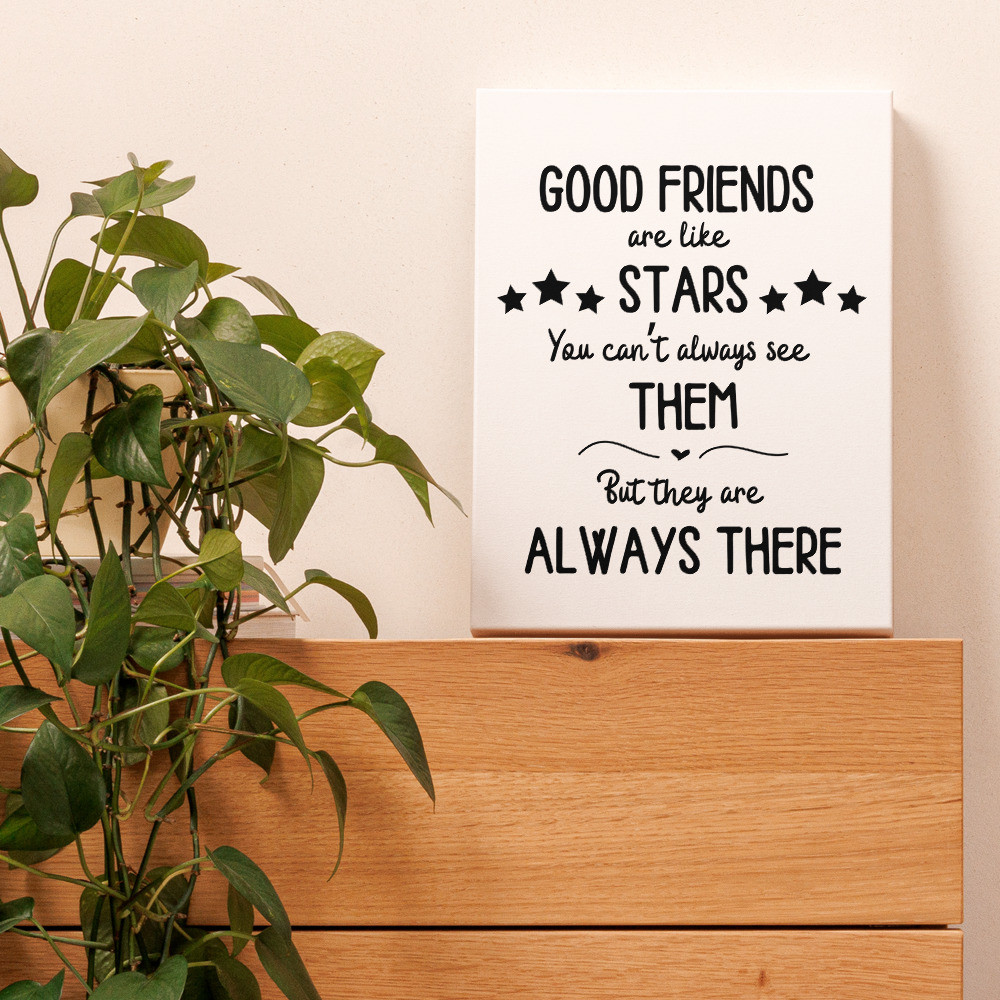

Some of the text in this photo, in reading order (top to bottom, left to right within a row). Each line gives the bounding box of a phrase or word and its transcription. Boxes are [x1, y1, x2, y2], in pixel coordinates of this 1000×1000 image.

[539, 164, 814, 213] GOOD FRIENDS
[627, 220, 731, 249] are like
[619, 264, 748, 314] STARS
[547, 321, 811, 371] You can't always see
[628, 381, 739, 431] THEM
[596, 468, 765, 514] But they are
[524, 525, 842, 575] ALWAYS THERE
